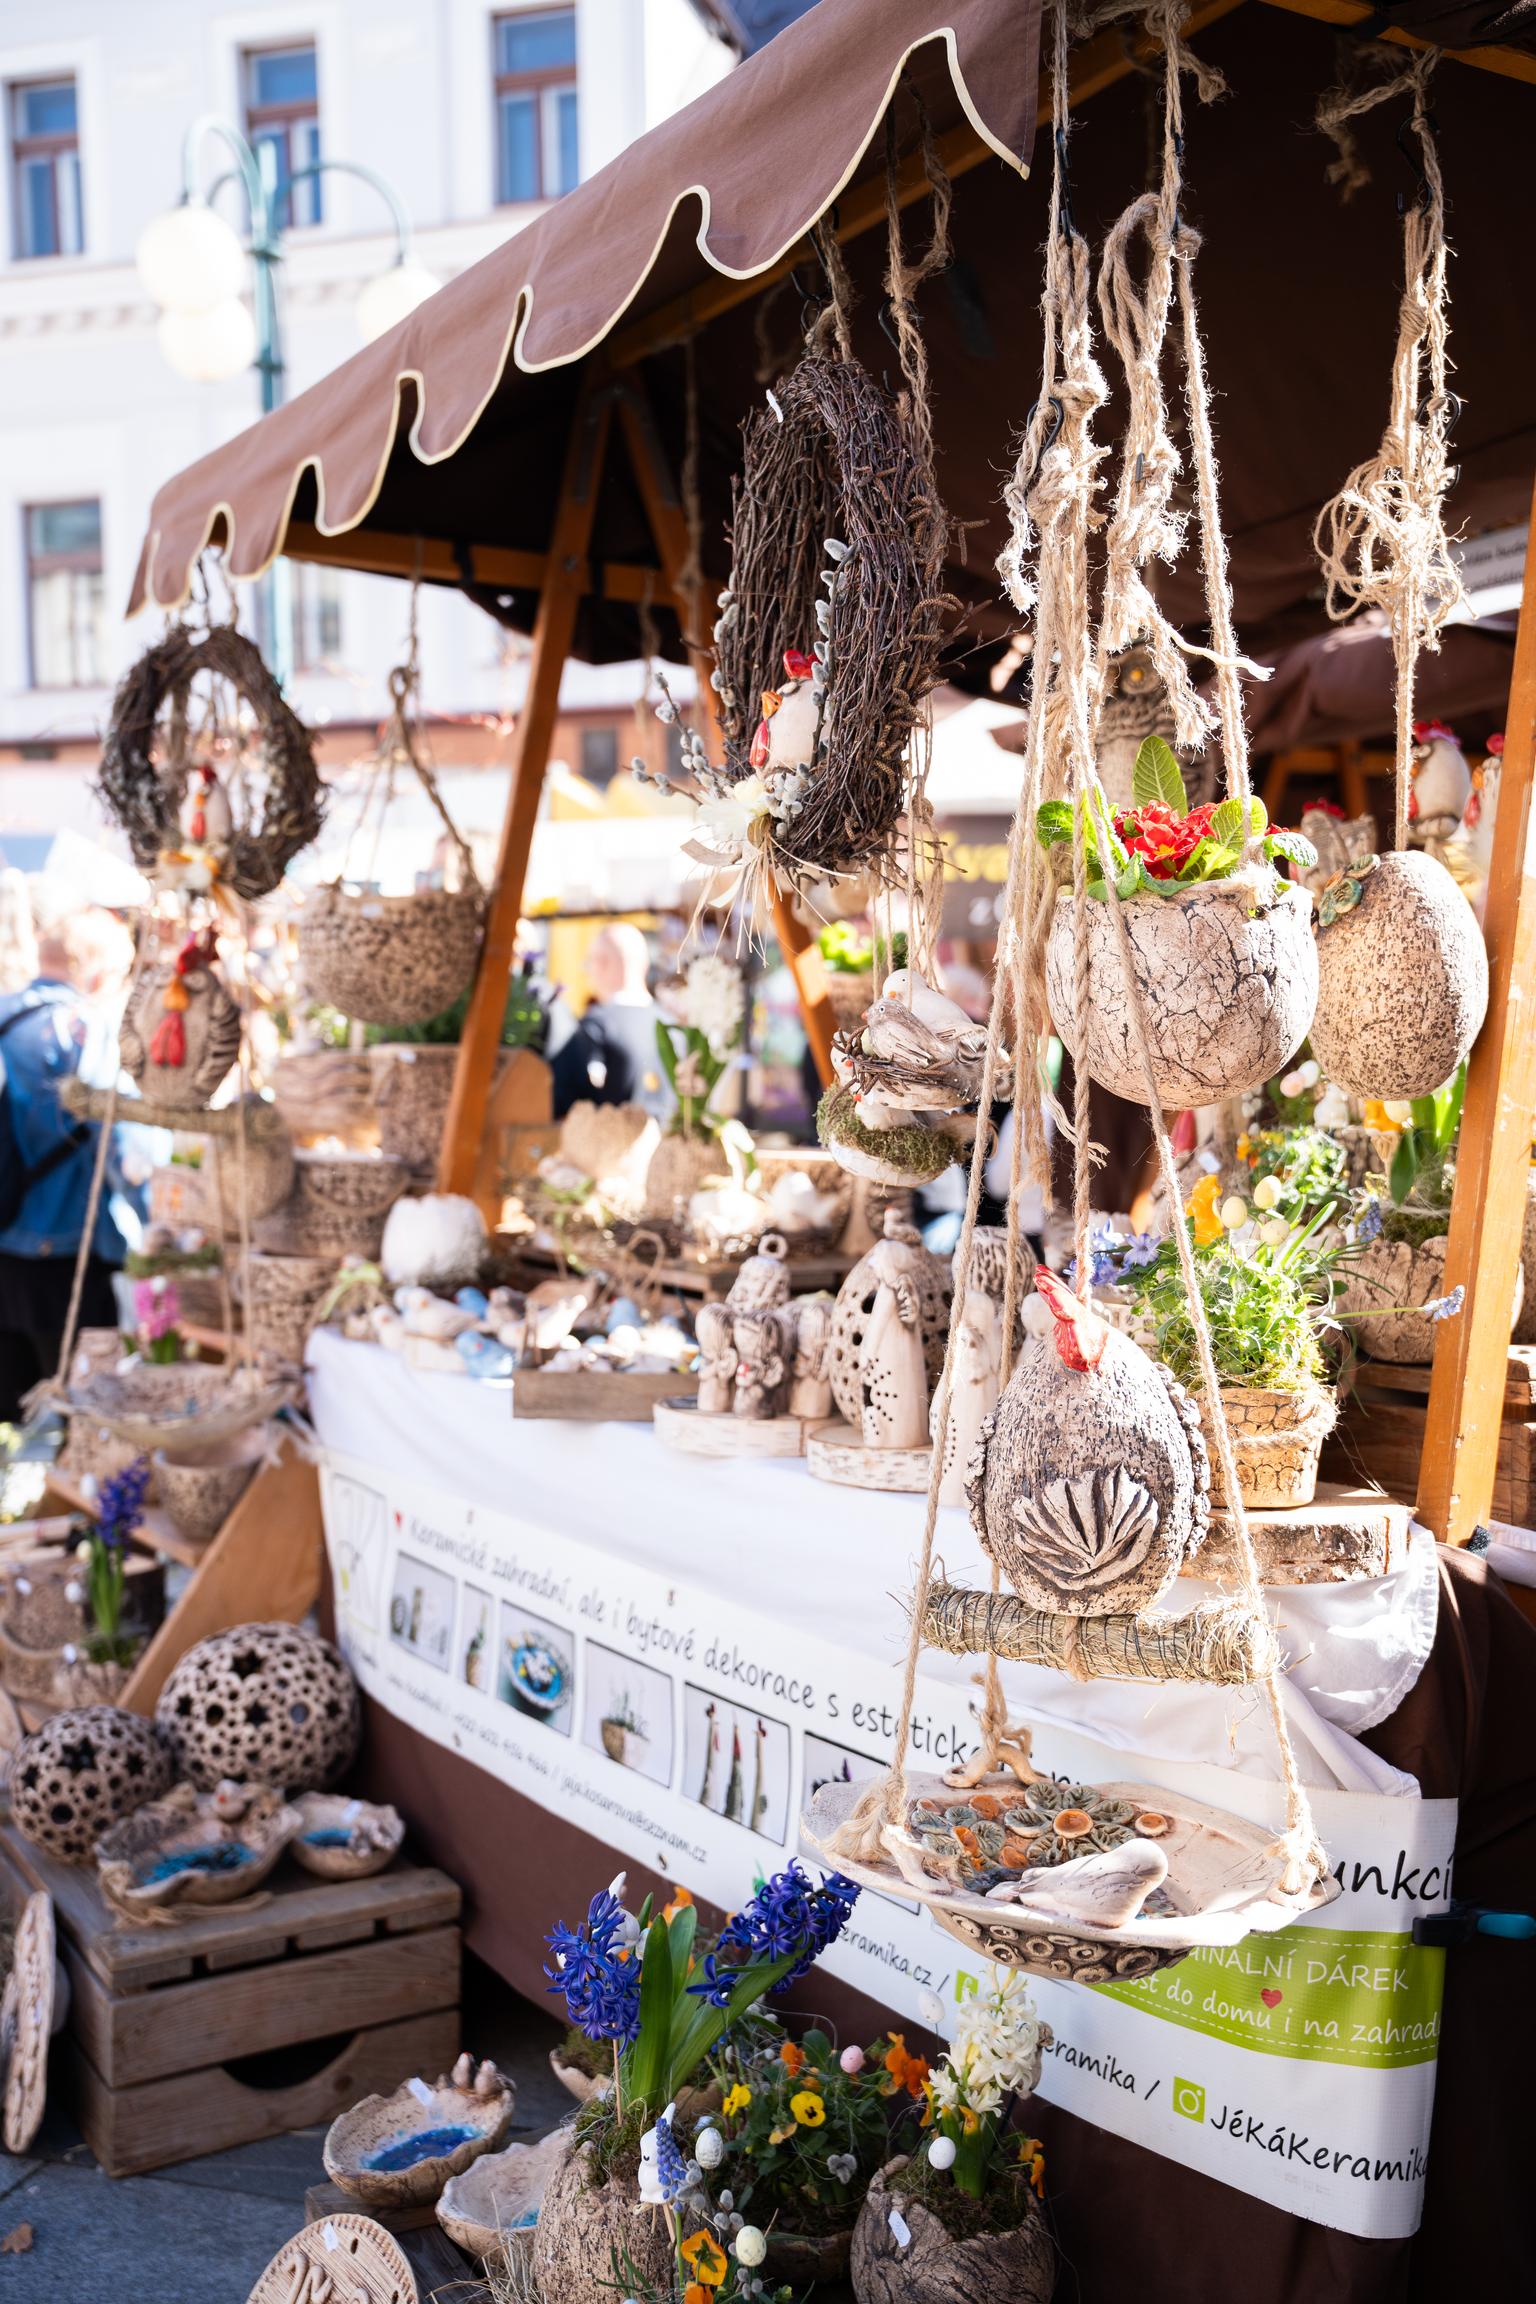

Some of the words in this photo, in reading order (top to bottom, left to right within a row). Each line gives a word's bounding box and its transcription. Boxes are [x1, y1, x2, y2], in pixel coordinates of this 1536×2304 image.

[411, 1518, 489, 1570] Keramické
[578, 1586, 605, 1622] ale
[611, 1595, 623, 1630] i
[626, 1600, 696, 1661] bytové
[703, 1638, 816, 1709] dekorace
[827, 1692, 840, 1718] s
[1306, 1954, 1409, 1993] DÁREK
[1166, 1976, 1193, 2006] do
[1202, 1989, 1272, 2032] domu
[1284, 2007, 1294, 2034] i
[1303, 2021, 1340, 2041] na
